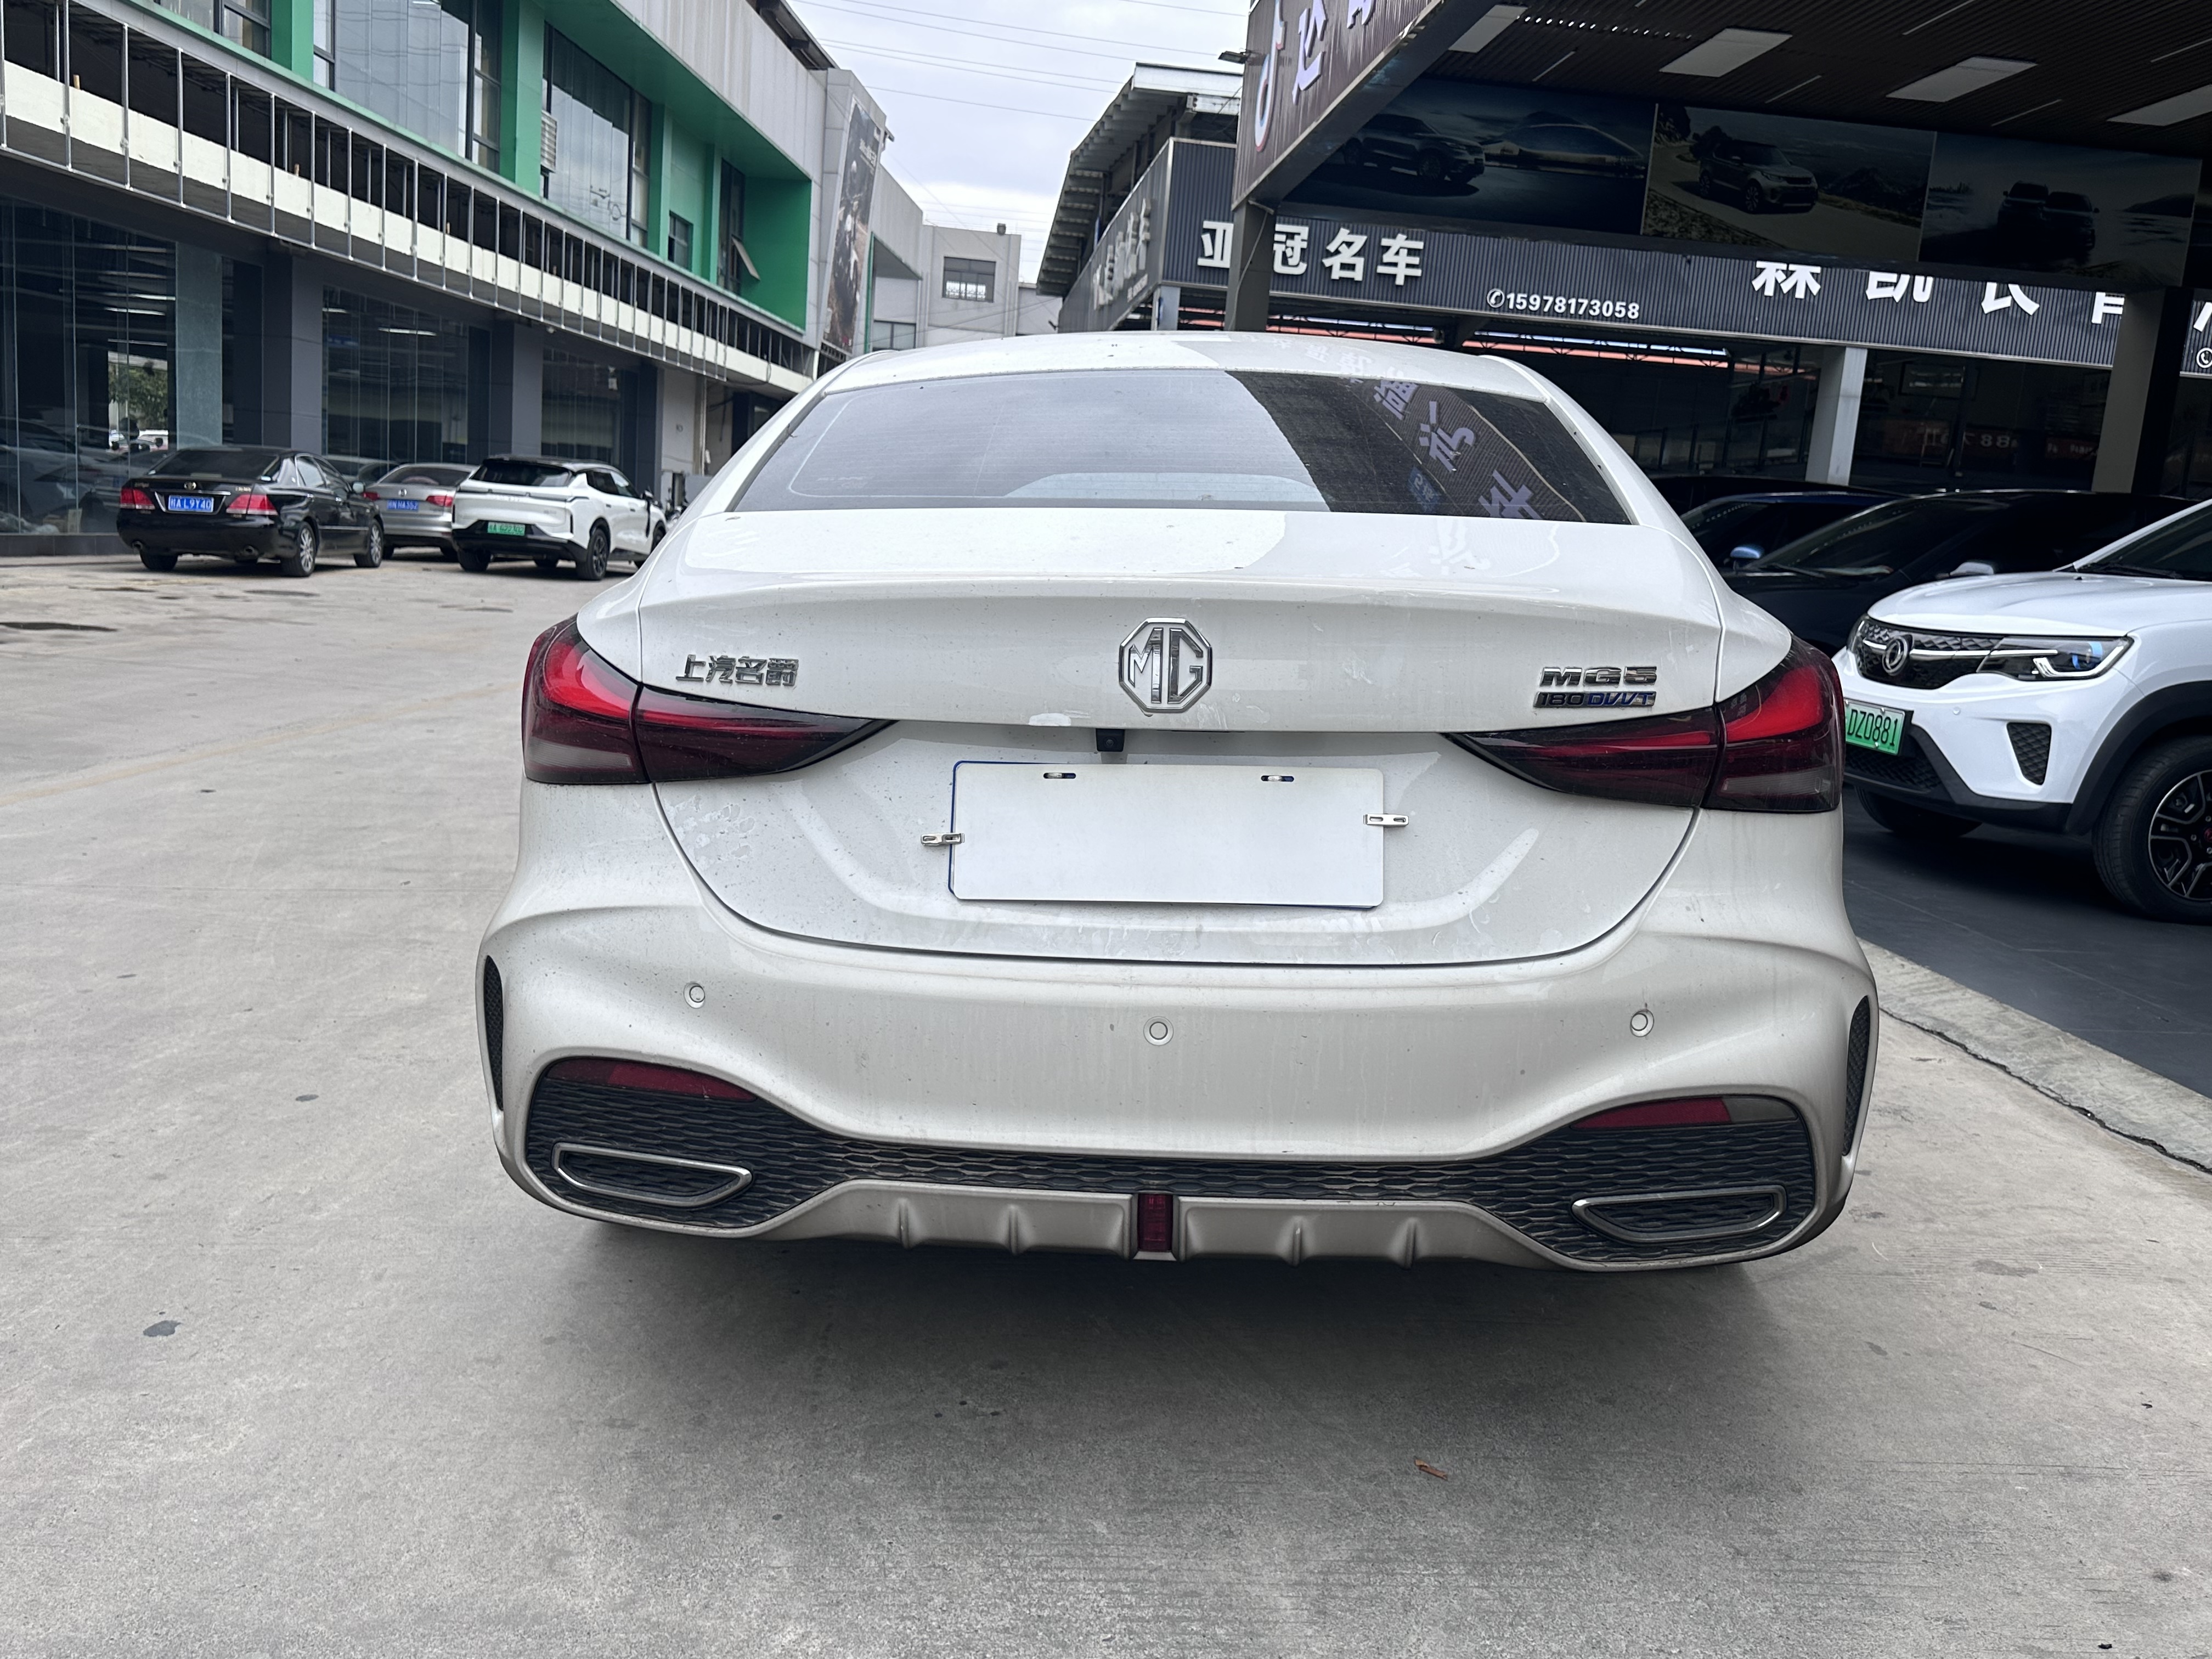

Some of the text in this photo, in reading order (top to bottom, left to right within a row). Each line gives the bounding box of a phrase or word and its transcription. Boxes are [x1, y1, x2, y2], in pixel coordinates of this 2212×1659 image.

[1197, 221, 1425, 286] 亚冠名车
[1506, 292, 1640, 319] 15978173058
[675, 654, 799, 686] 上汽名爵
[1127, 627, 1204, 704] MG
[1539, 666, 1657, 687] MG5
[1847, 709, 1898, 747] DZ0881
